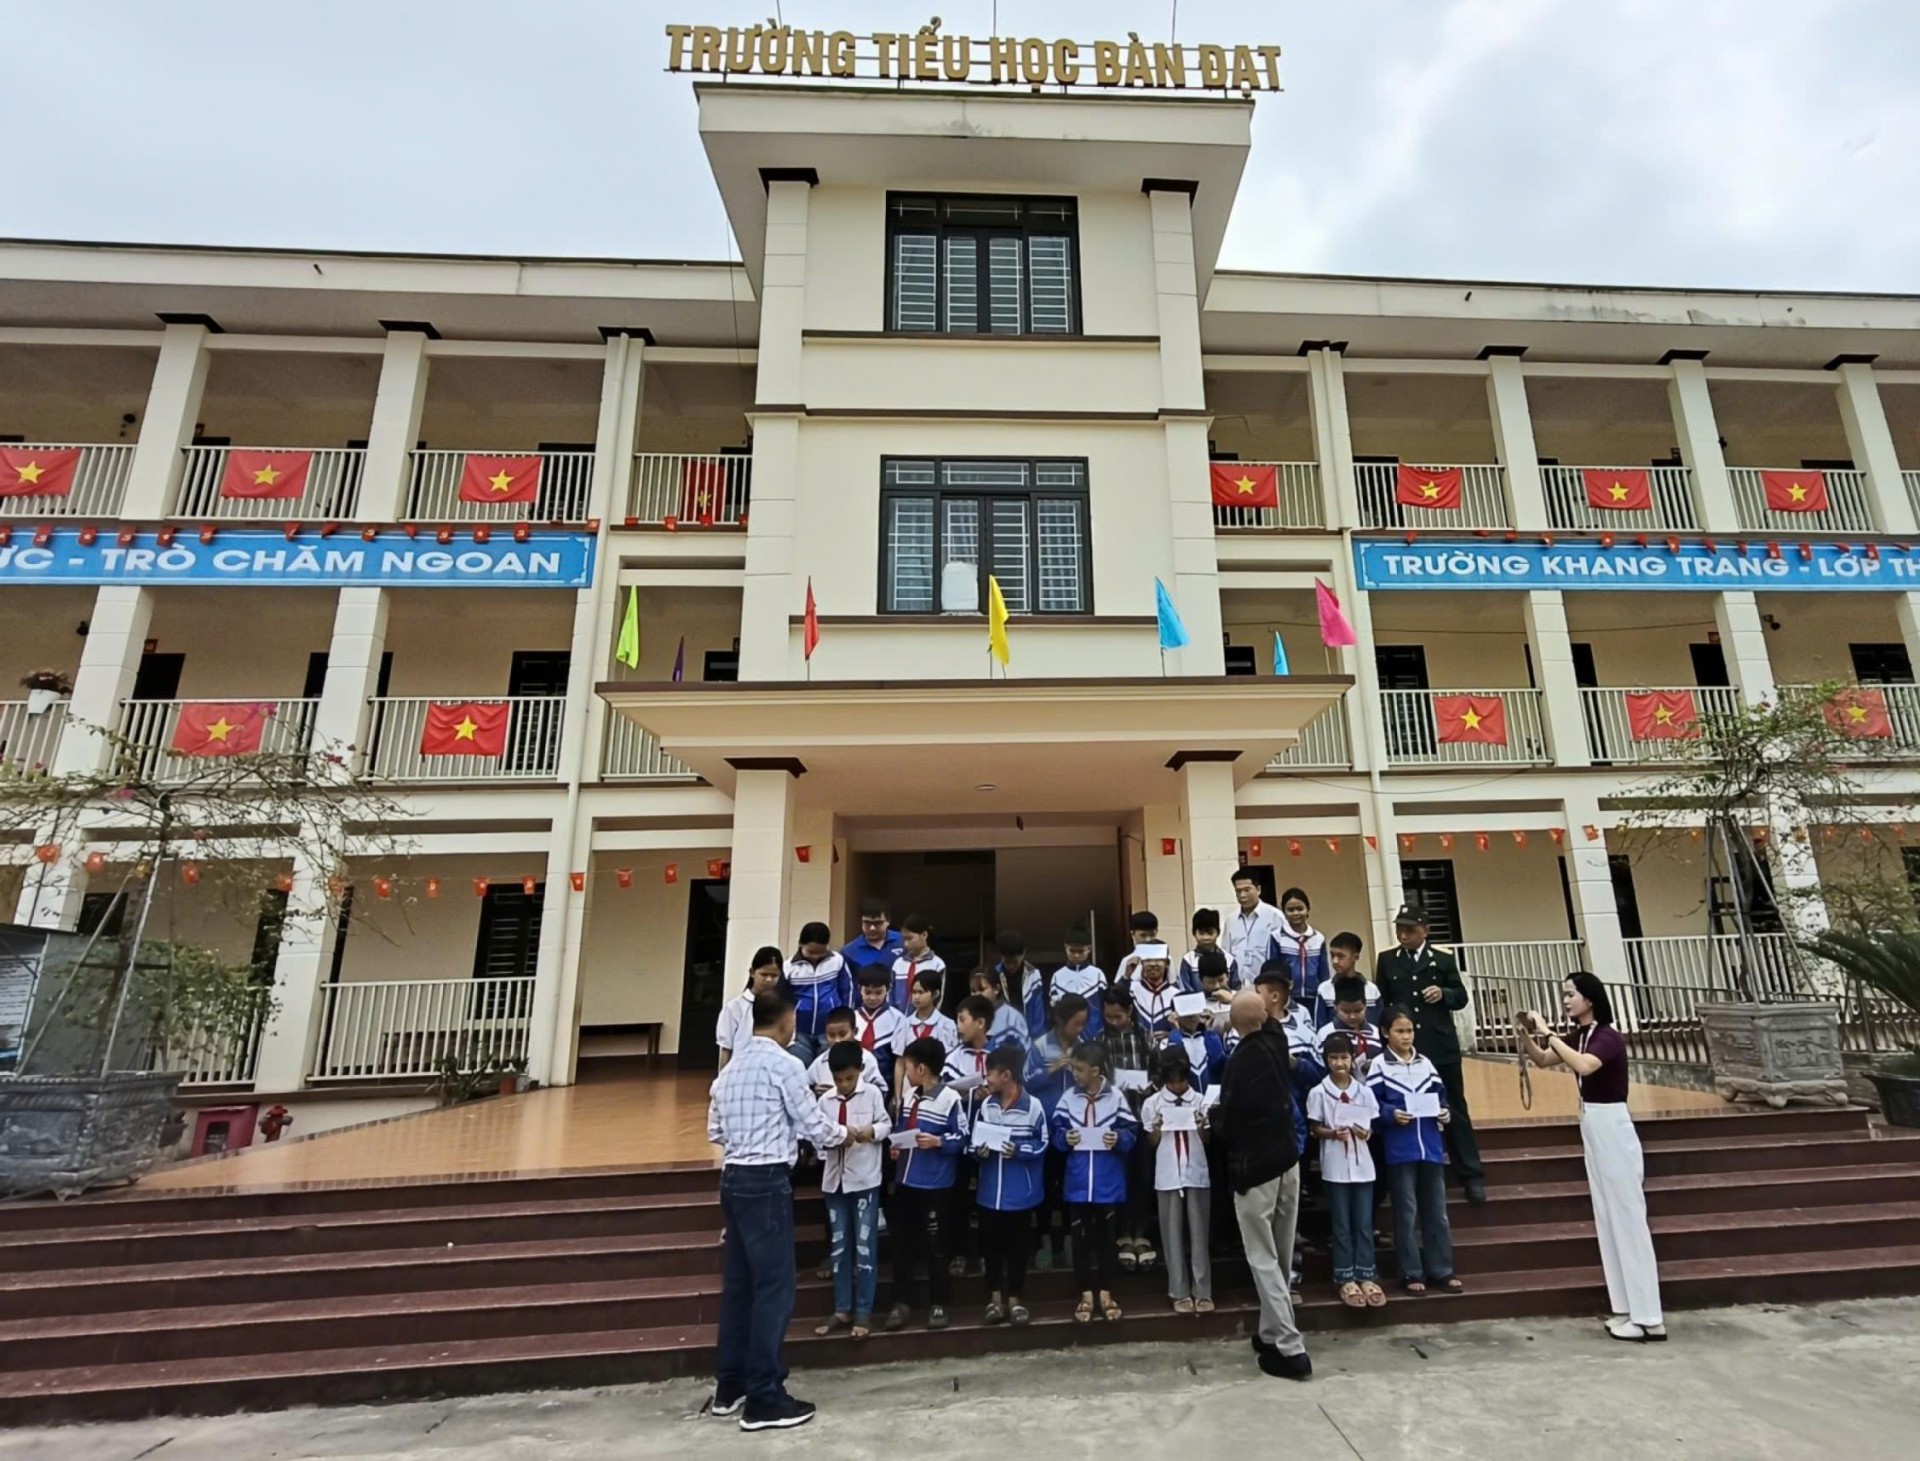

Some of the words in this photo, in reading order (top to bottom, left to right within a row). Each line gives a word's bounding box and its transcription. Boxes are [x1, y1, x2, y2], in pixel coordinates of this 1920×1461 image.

[666, 18, 856, 78] TRƯỜNG
[872, 16, 970, 81] TIỂU
[989, 36, 1080, 93] HỌC
[1094, 32, 1186, 89] BÀN
[1199, 43, 1281, 98] ĐẠT
[101, 543, 196, 571] TRÒ
[213, 545, 364, 572] CHĂM
[381, 551, 560, 574] NGOAN
[1383, 550, 1530, 576] TRƯỜNG
[1542, 556, 1667, 576] KHANG
[1676, 557, 1790, 577] TRANG
[1818, 553, 1880, 577] LỚP
